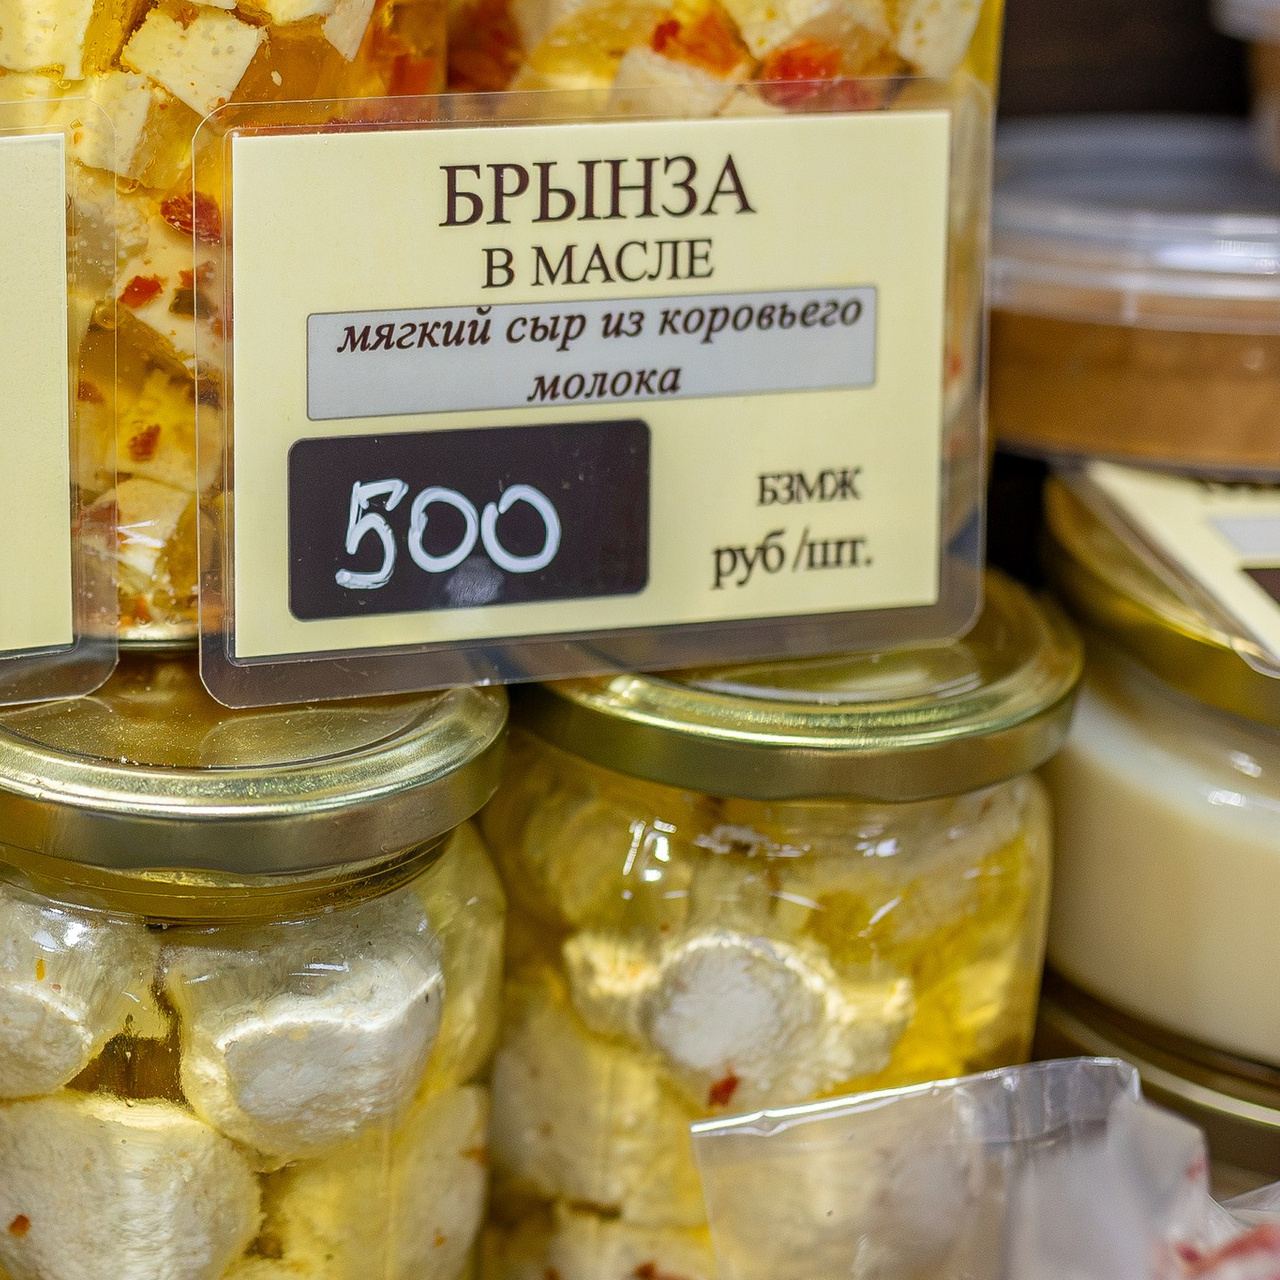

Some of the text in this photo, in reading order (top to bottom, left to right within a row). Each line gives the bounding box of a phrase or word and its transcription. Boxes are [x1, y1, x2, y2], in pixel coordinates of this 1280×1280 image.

[438, 153, 756, 227] БРЫНЗА
[480, 238, 715, 289] В МАСЛЕ
[336, 296, 864, 354] мягкий сыр из коровьего
[526, 362, 682, 403] молока
[756, 466, 863, 506] БЗМЖ
[335, 478, 562, 590] 500
